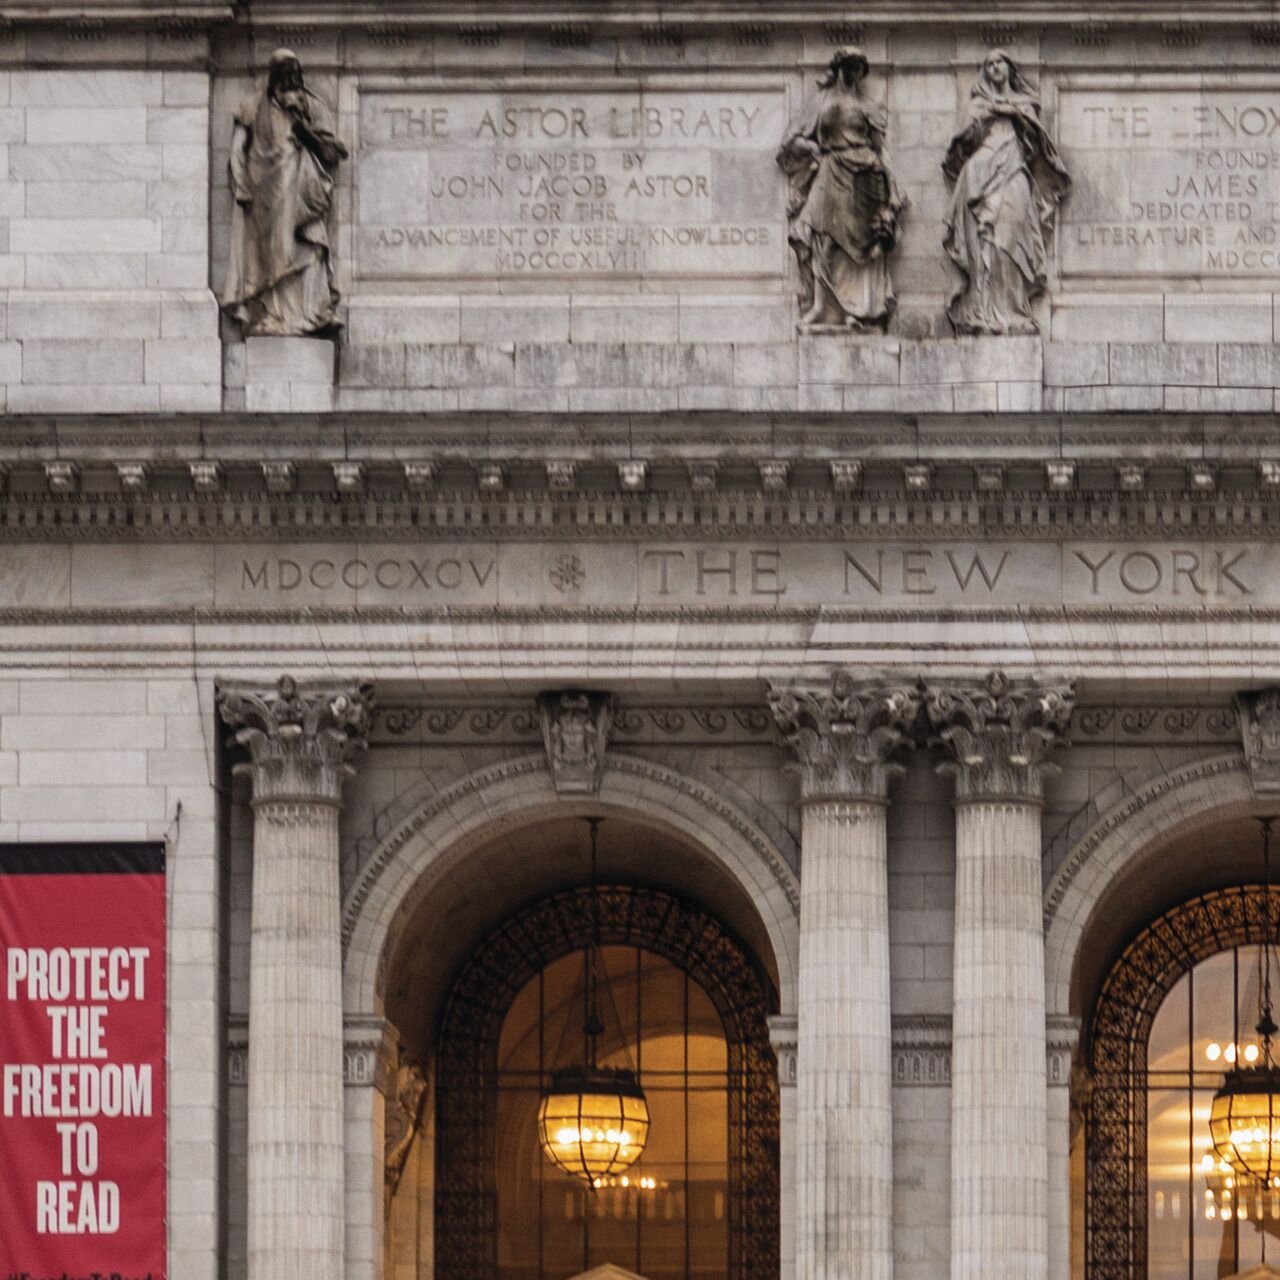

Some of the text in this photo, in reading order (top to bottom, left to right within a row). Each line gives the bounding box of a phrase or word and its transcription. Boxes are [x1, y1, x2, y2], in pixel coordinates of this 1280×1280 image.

[383, 107, 760, 138] THE ASTOR LIBRARY
[1083, 107, 1150, 138] THE
[495, 153, 646, 170] FOUNDED BY
[431, 175, 709, 199] JOHN JACOB ASTOR
[1165, 175, 1258, 198] JAMES
[519, 202, 618, 221] FOR THE
[1131, 202, 1252, 221] DEDICATED
[376, 227, 769, 247] ADVANCEMENT OF USEFUL KNOWLEDGE
[1077, 227, 1216, 246] LITERATURE
[1235, 226, 1276, 245] AND
[240, 558, 495, 591] MDCCCXCV
[642, 550, 787, 596] THE
[841, 550, 1012, 595] NEW
[1073, 550, 1254, 596] YORK
[7, 947, 150, 1001] PROTECT
[47, 1006, 108, 1059] THE
[3, 1064, 152, 1117] FREEDOM
[56, 1121, 98, 1176] TO
[36, 1180, 120, 1234] READ
